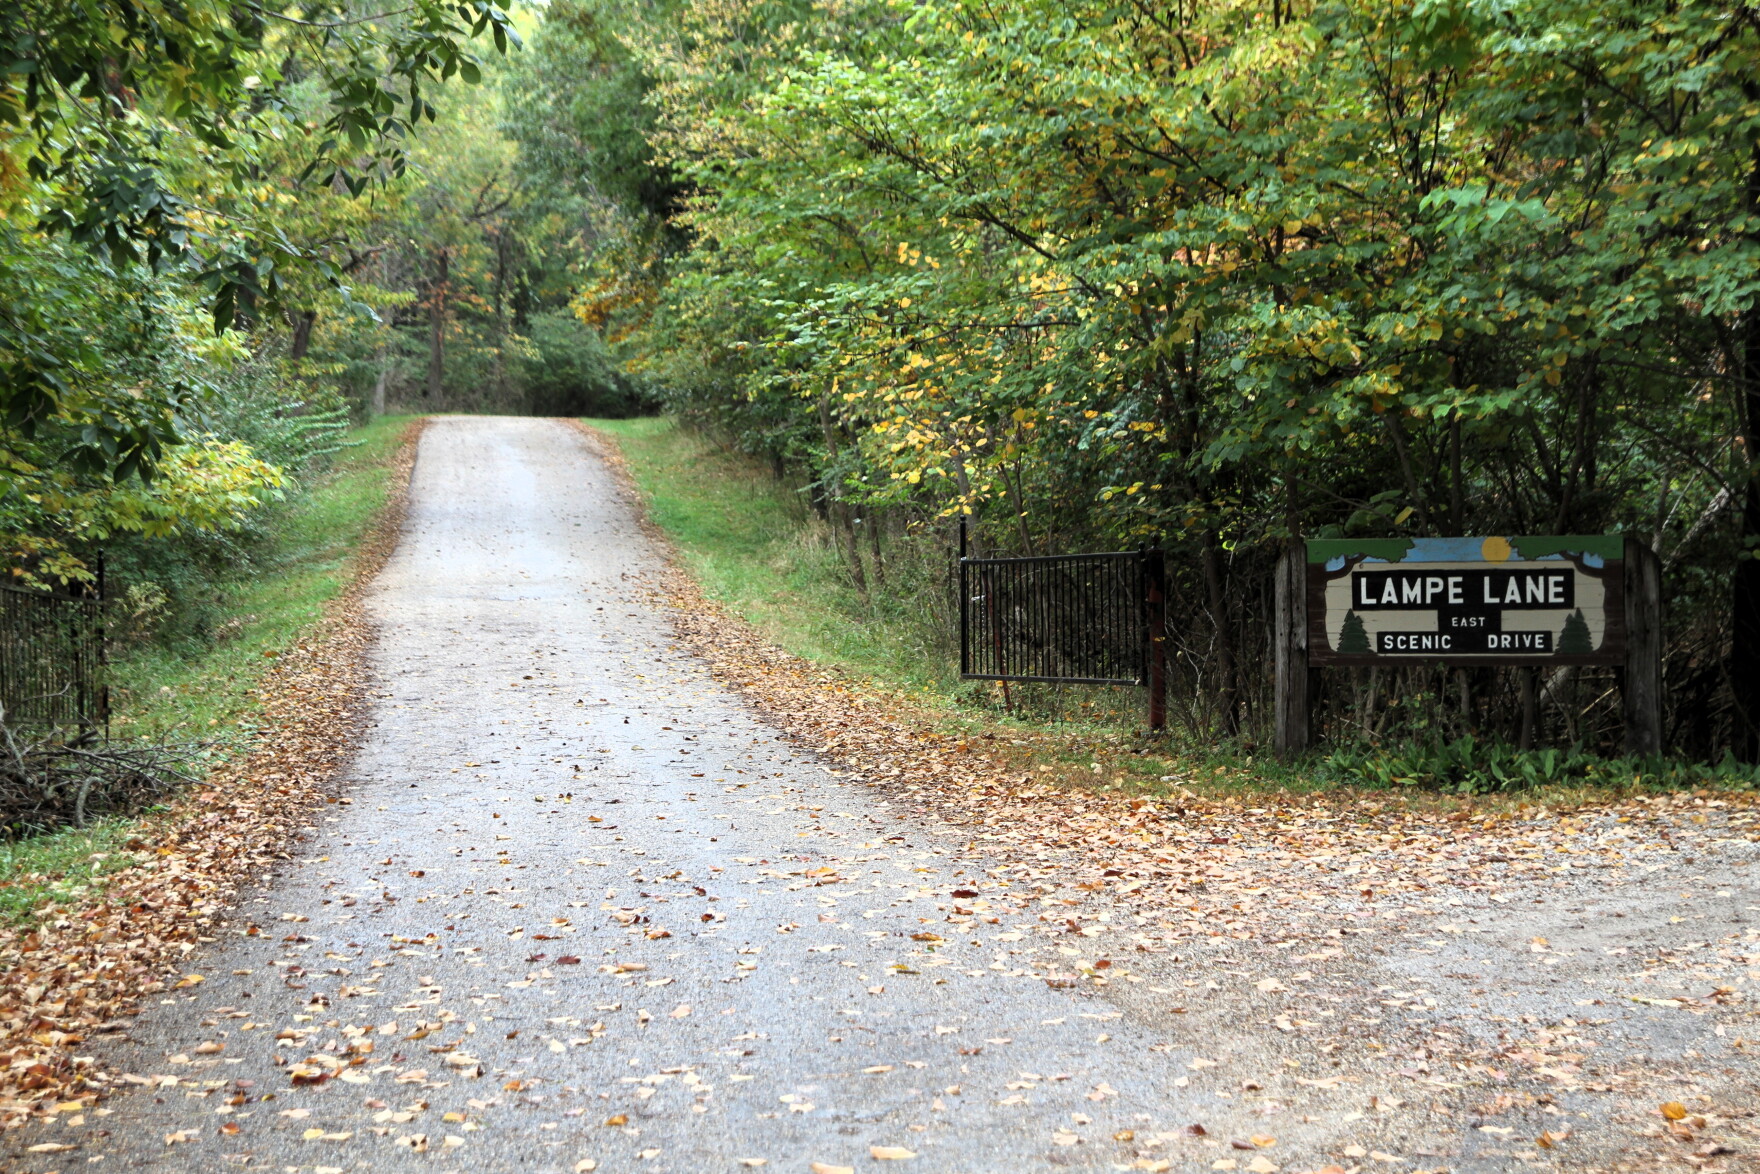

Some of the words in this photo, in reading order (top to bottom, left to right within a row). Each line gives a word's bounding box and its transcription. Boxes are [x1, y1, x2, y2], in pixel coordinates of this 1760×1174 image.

[1360, 576, 1464, 605] LAMPE
[1483, 575, 1565, 604] LANE
[1451, 616, 1486, 627] EAST
[1384, 634, 1452, 649] SCENIC
[1487, 633, 1545, 648] DRIVE
